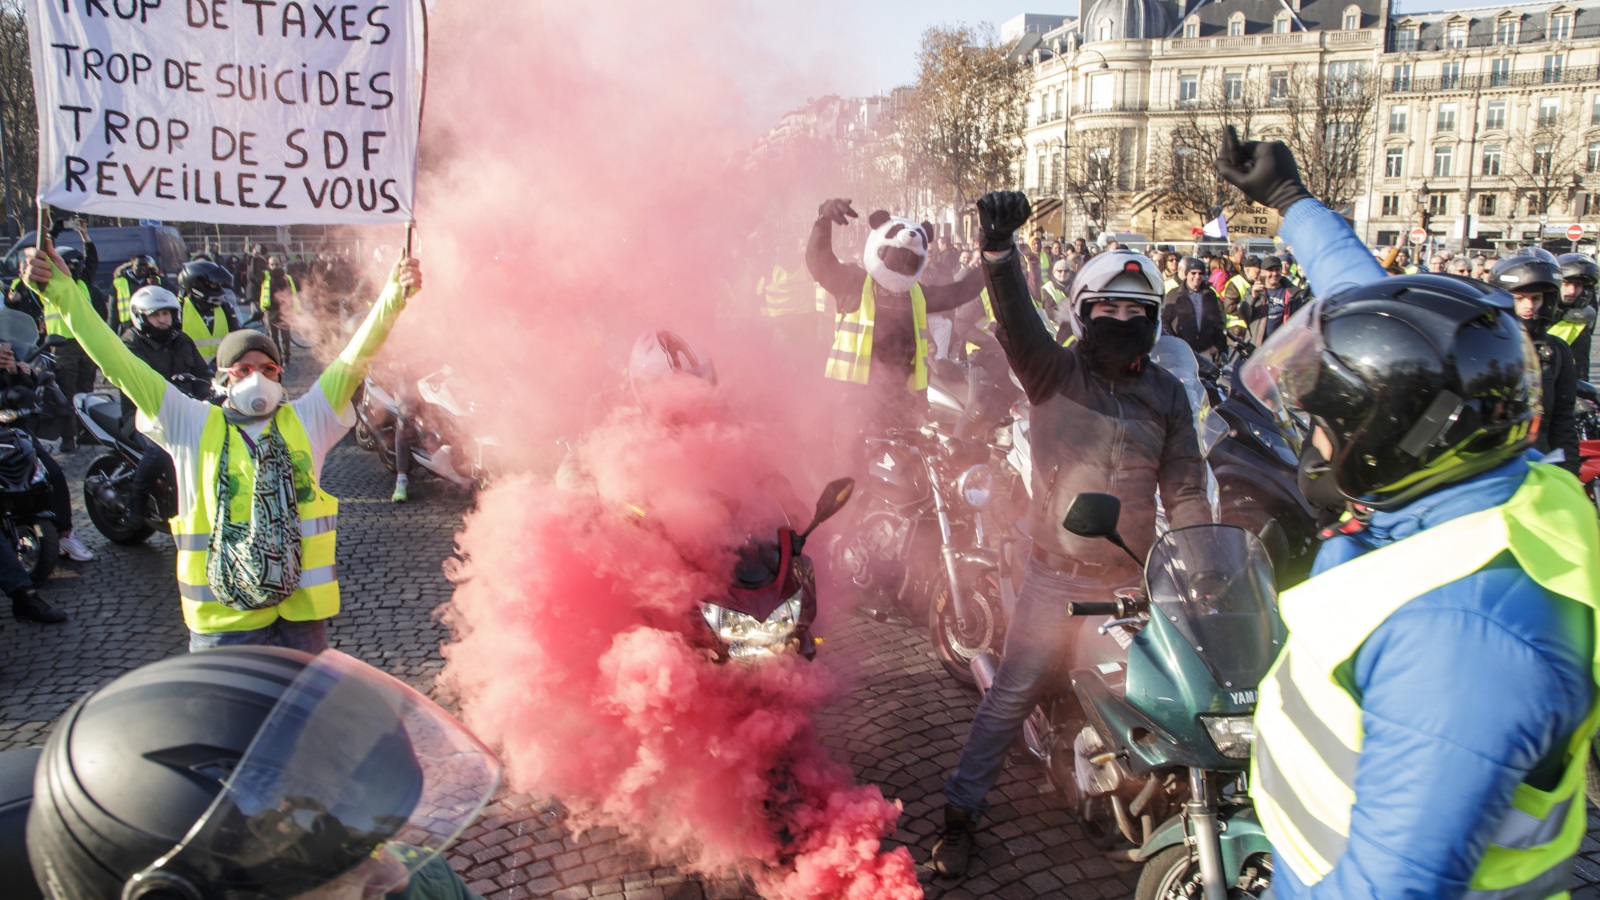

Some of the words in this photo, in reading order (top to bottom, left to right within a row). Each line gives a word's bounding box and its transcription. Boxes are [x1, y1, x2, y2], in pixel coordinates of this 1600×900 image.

[187, 0, 229, 29] DE
[242, 0, 391, 45] TAXES
[51, 43, 152, 85] TROP
[165, 59, 205, 93] DE
[60, 105, 190, 154] TROP
[212, 127, 259, 166] DE
[303, 177, 400, 214] VOUS
[1227, 225, 1267, 234] CREATE
[1253, 216, 1267, 224] TO
